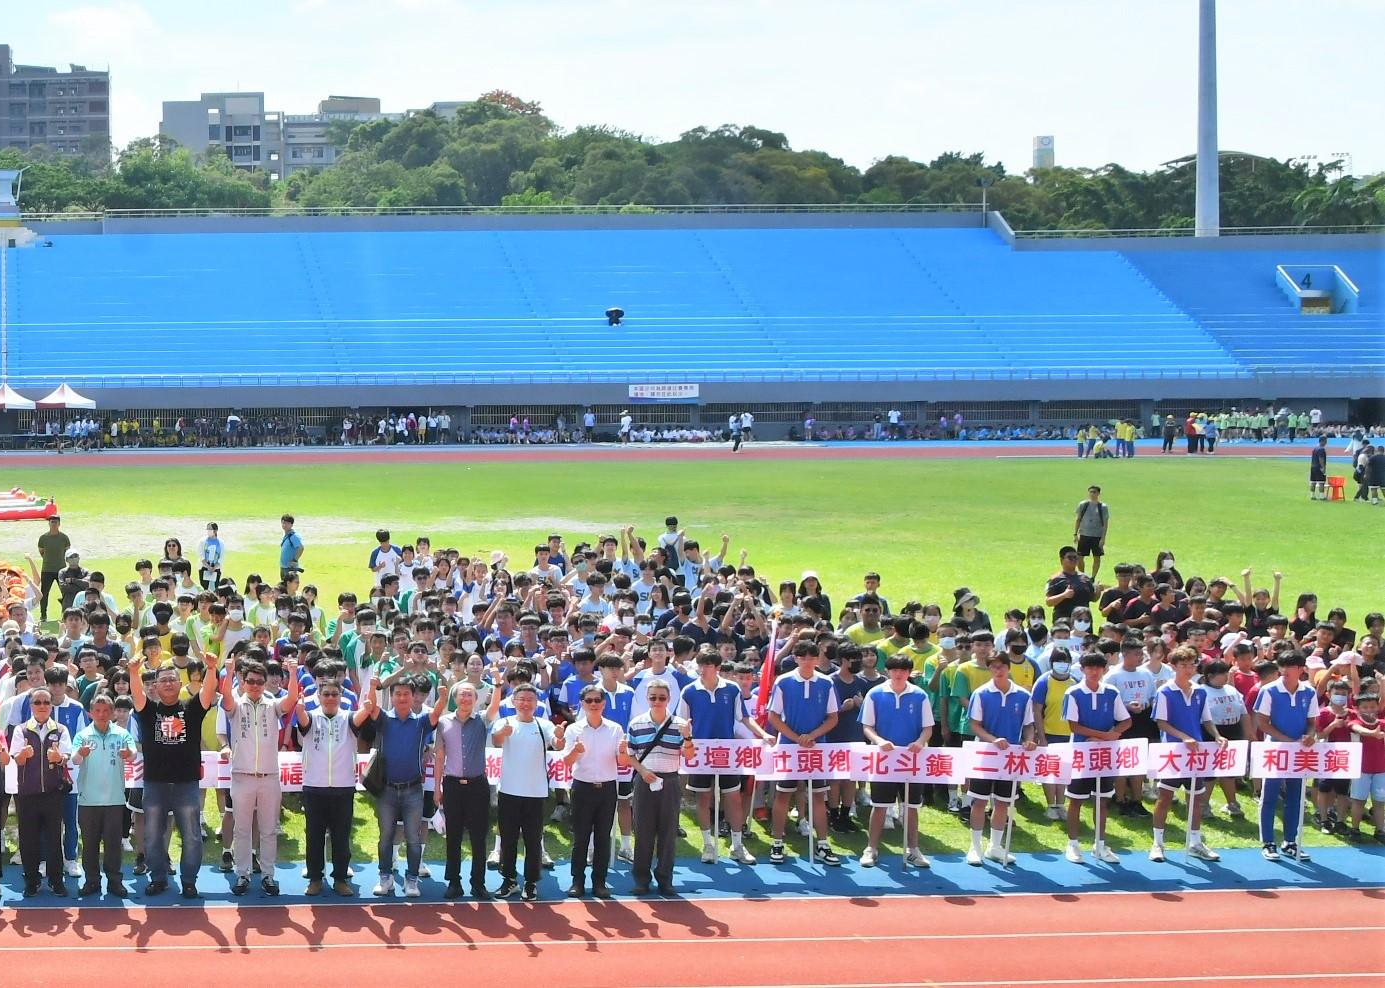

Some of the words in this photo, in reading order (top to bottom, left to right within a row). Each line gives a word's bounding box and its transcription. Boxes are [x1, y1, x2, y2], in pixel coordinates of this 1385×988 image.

[1301, 273, 1312, 288] 4
[1158, 747, 1236, 773] 大村鄉
